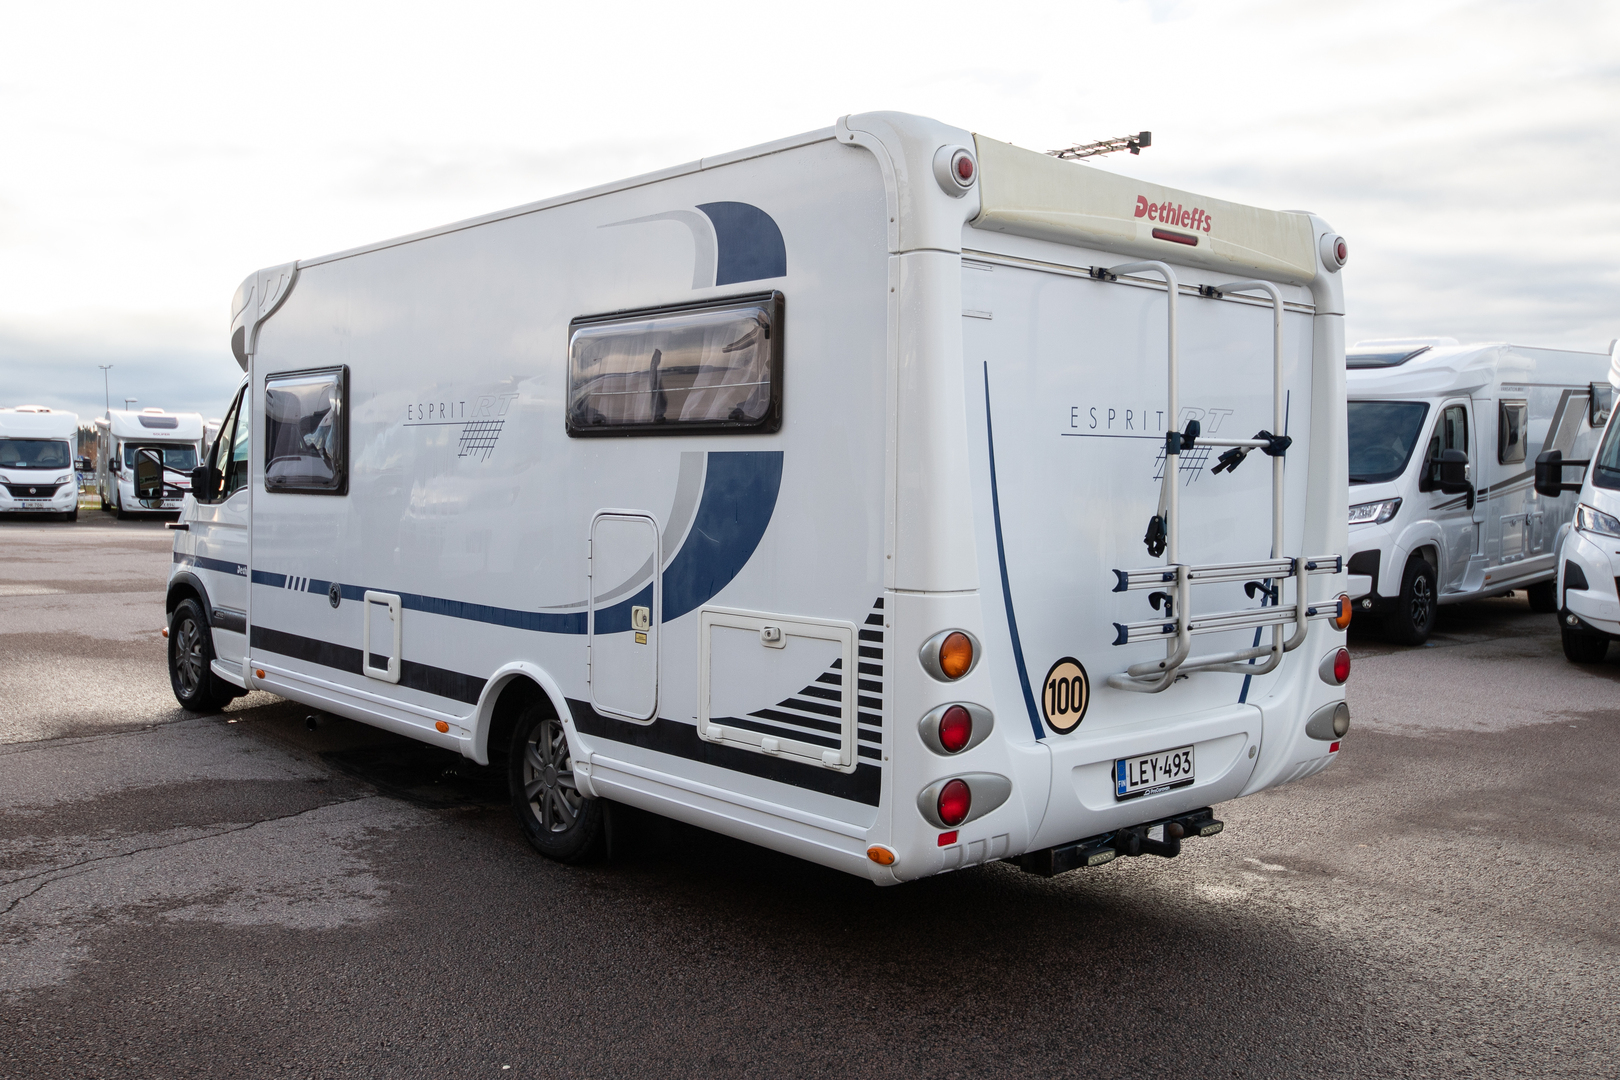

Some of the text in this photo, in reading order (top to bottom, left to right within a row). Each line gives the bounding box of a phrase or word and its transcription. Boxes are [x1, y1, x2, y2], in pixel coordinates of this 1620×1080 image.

[1134, 194, 1212, 233] Dethleffs
[407, 392, 520, 421] ESPRIT RT
[1070, 406, 1234, 433] ESPRIT RT
[1048, 675, 1084, 716] 100
[1118, 779, 1126, 788] FIN
[1129, 751, 1191, 786] LEY-493
